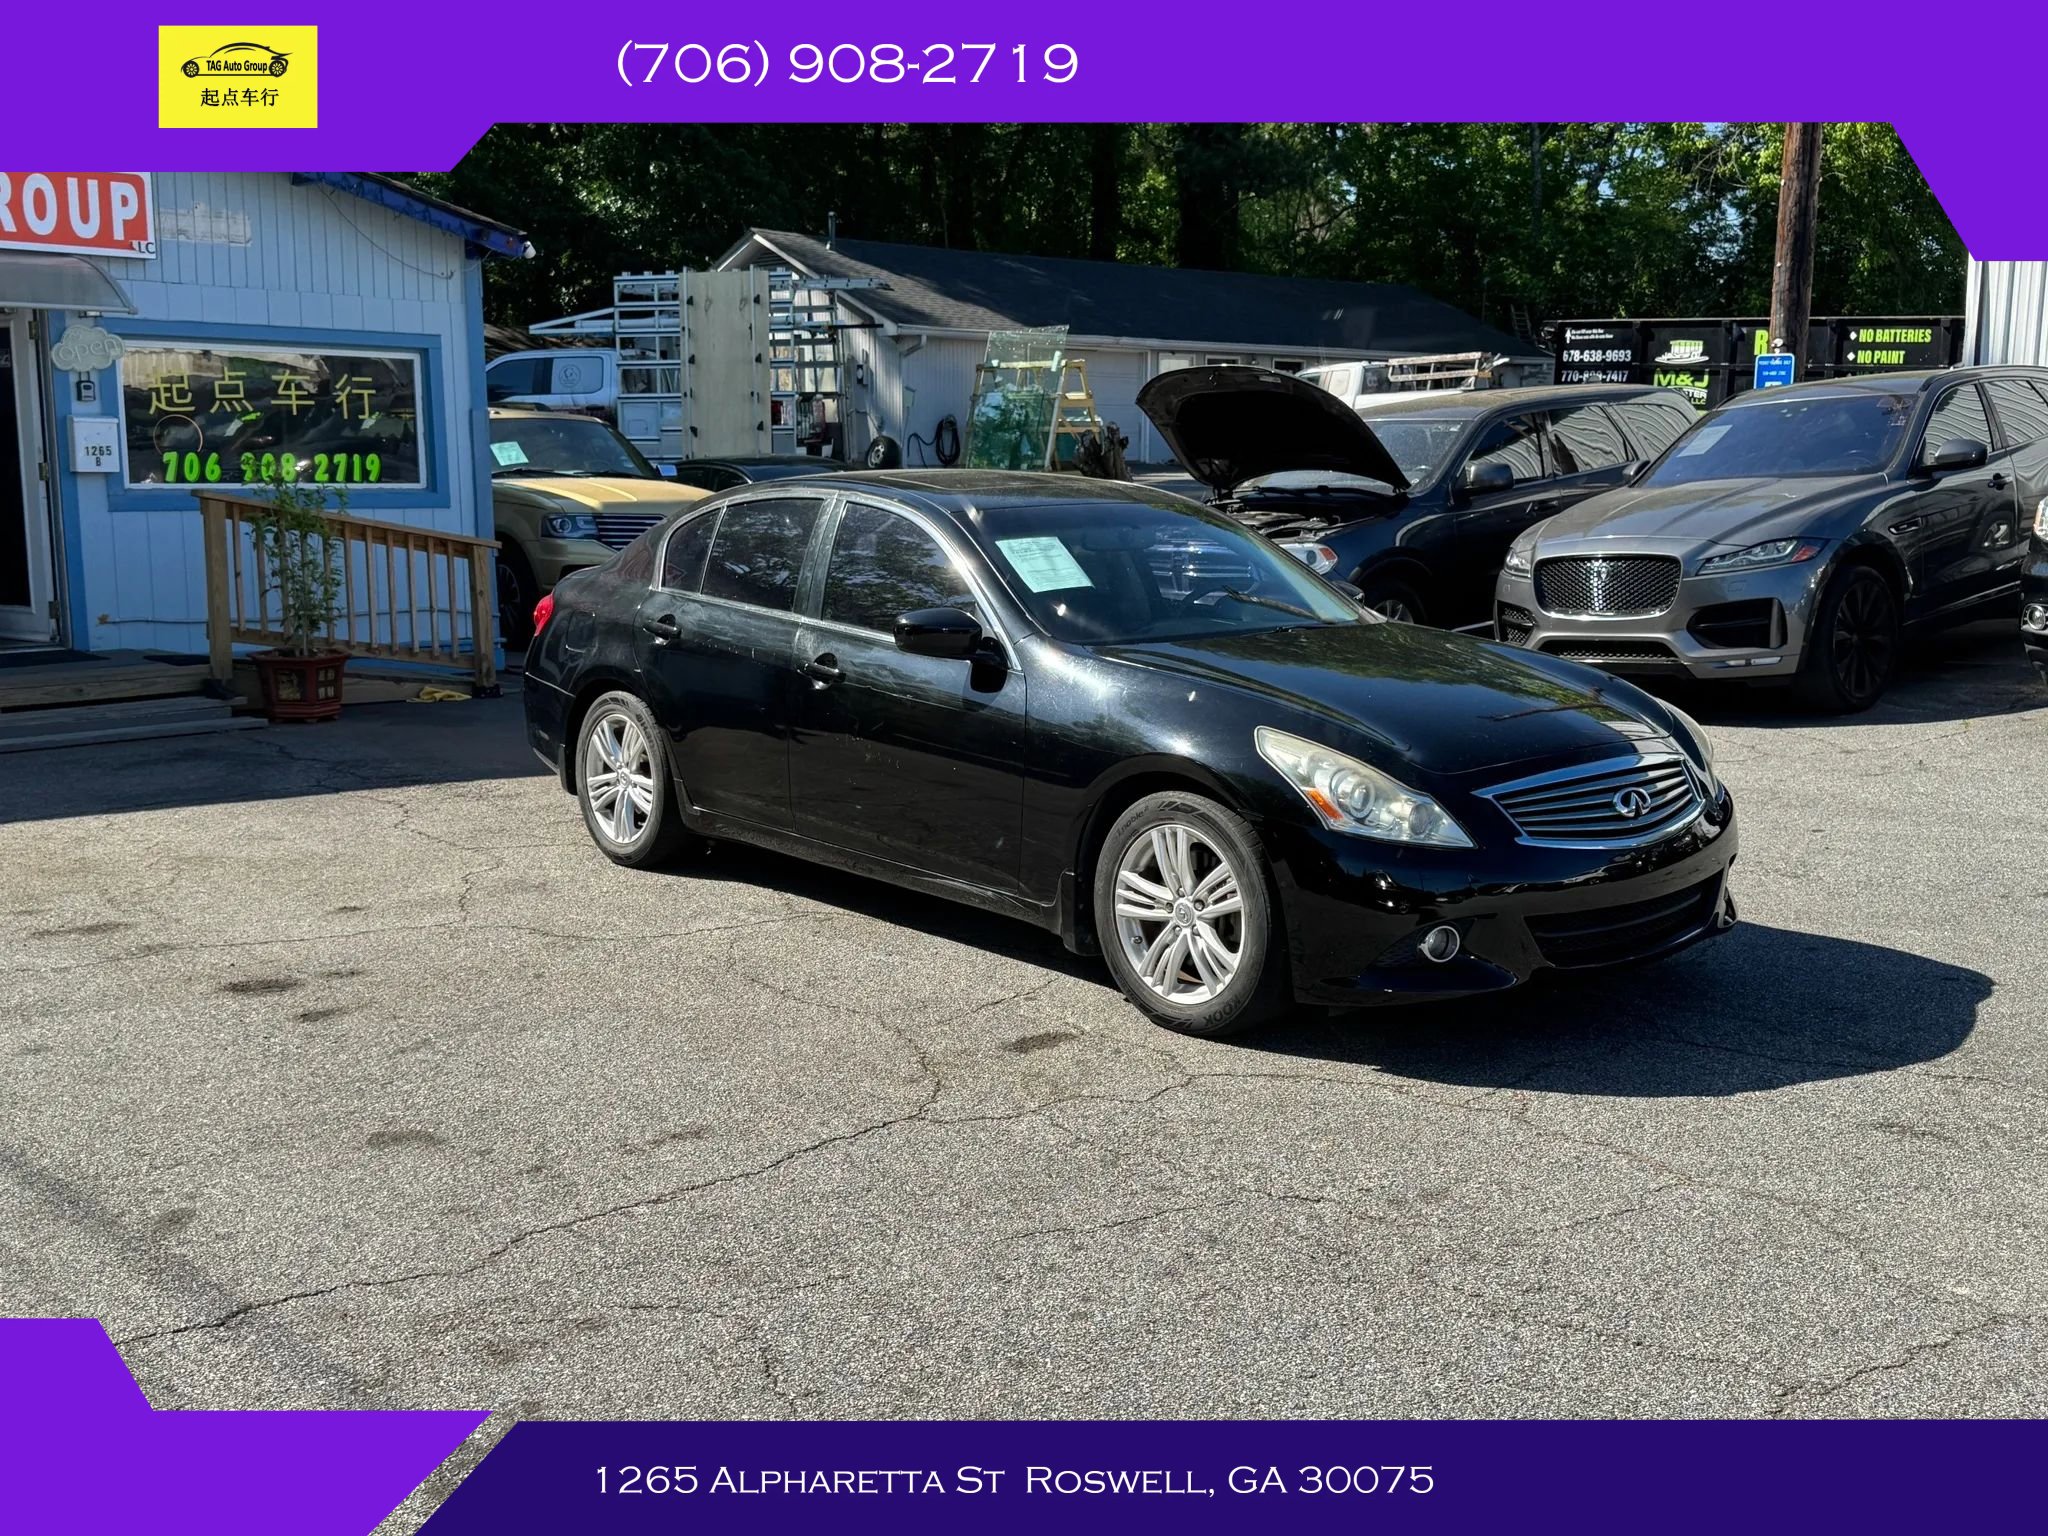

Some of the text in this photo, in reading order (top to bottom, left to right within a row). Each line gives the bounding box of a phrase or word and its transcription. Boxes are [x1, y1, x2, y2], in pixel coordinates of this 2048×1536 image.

[1859, 328, 1932, 343] NO BATTERIES
[1562, 350, 1632, 362] 678-638-9693
[1857, 350, 1905, 364] NO PAINT
[1653, 368, 1709, 388] M&J
[149, 366, 377, 420] 起点车行
[84, 445, 112, 456] 1265
[95, 456, 101, 467] B
[163, 451, 381, 483] 706 908 2719
